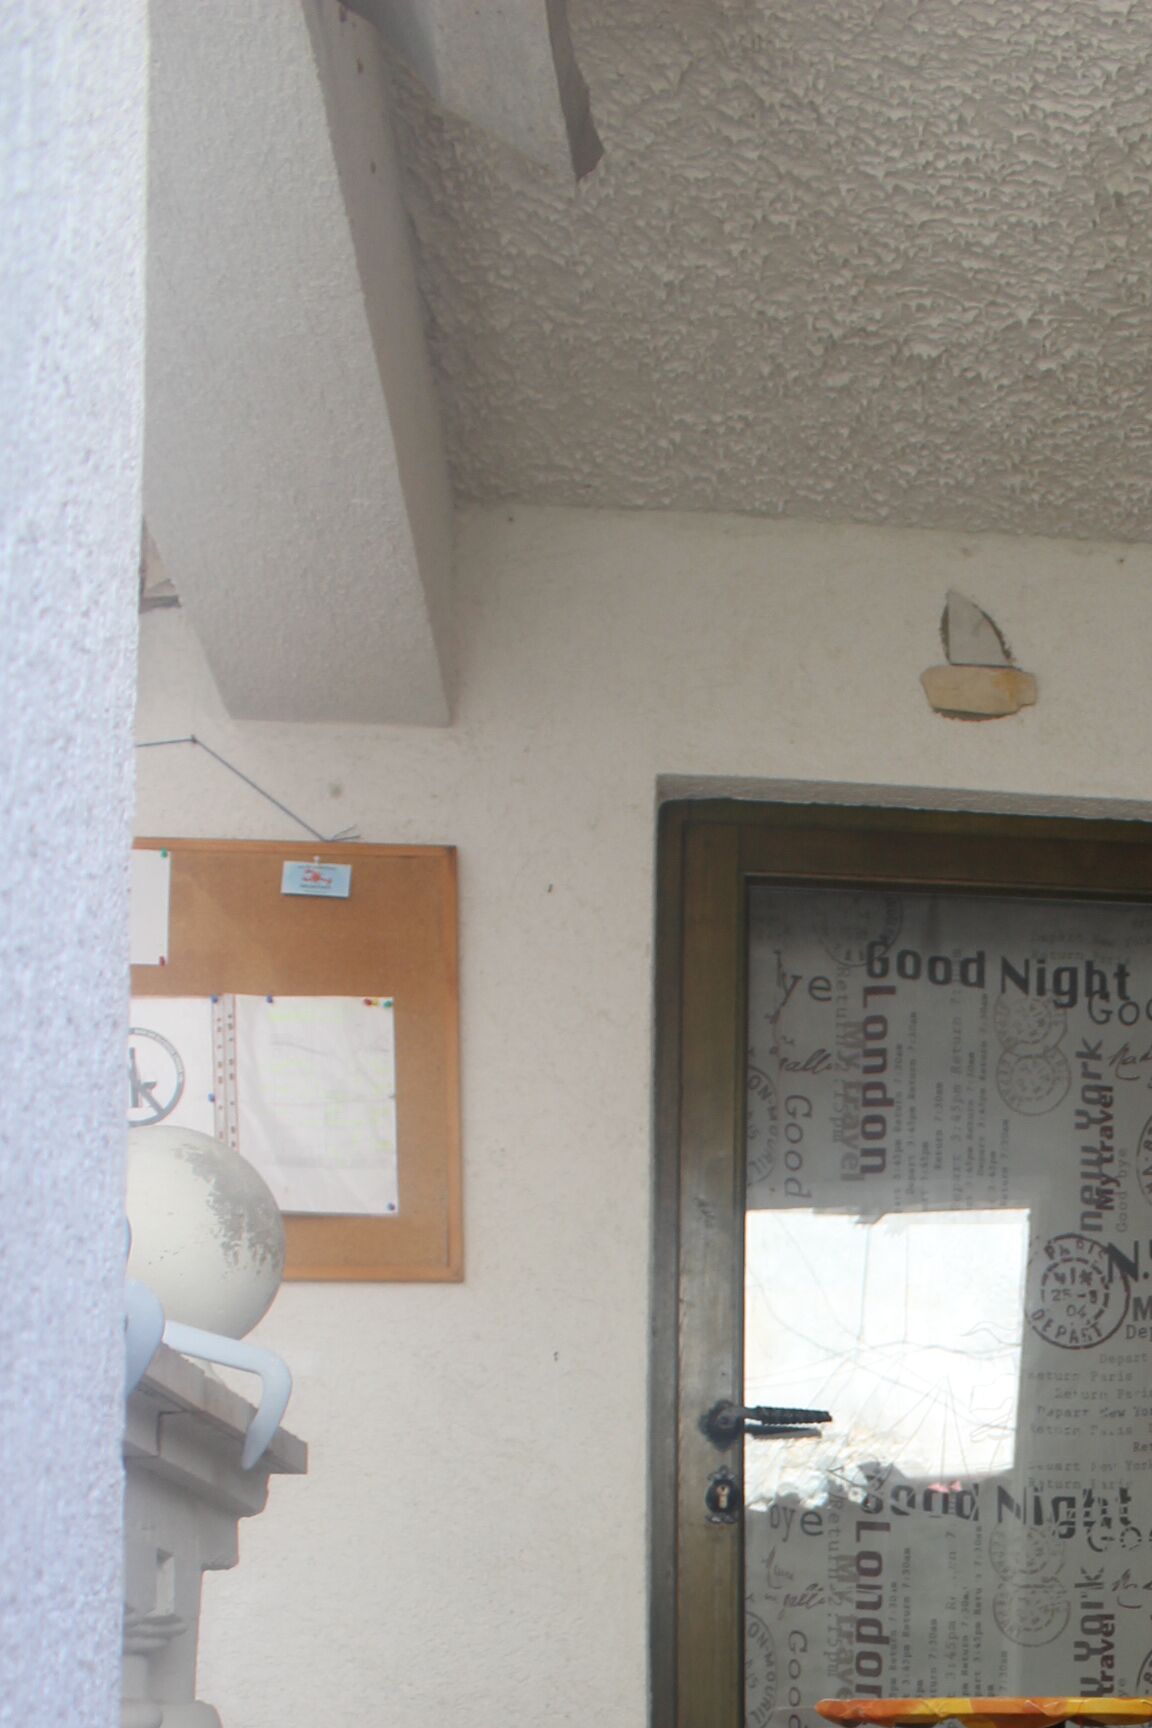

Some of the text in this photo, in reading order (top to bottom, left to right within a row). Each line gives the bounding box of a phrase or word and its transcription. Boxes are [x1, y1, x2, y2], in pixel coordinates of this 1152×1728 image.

[866, 941, 985, 988] Good
[1001, 955, 1131, 1009] Night
[859, 985, 897, 1174] London
[1074, 1037, 1104, 1131] York
[834, 1614, 859, 1700] trave
